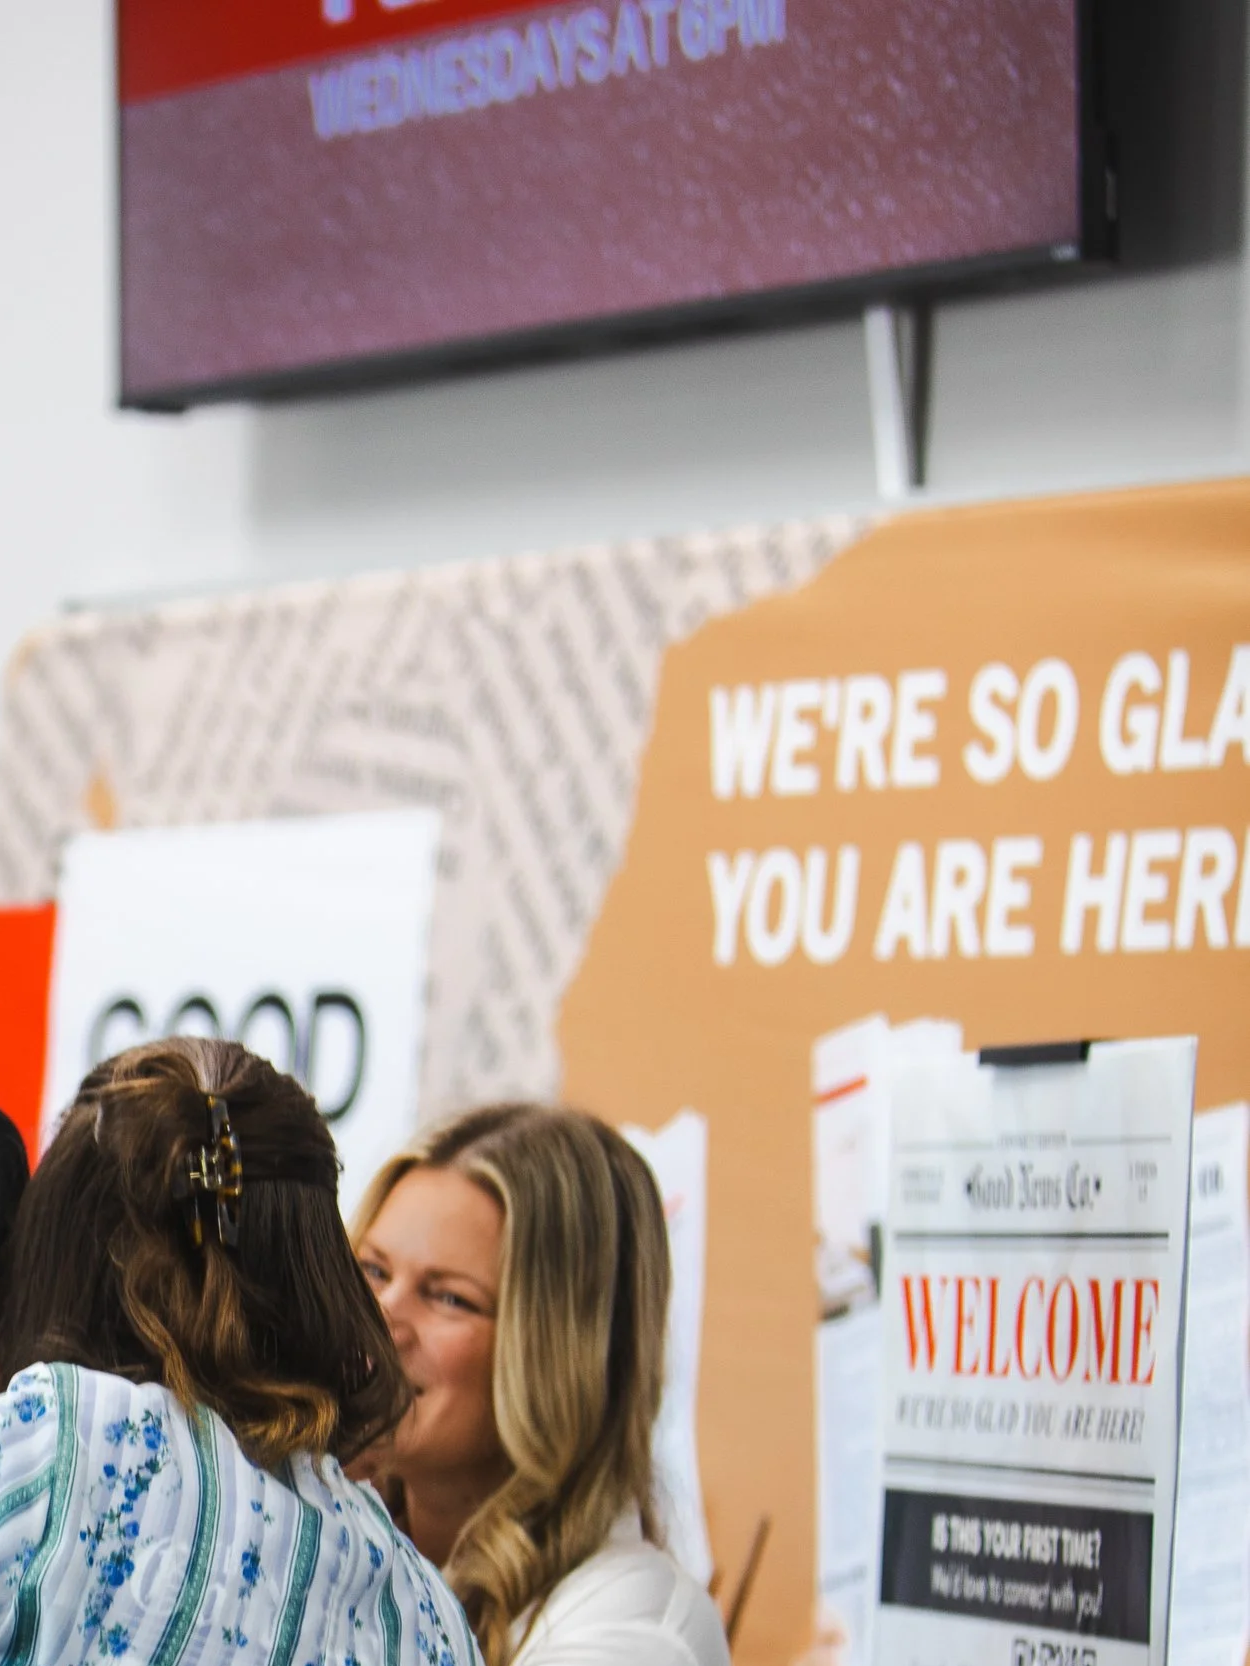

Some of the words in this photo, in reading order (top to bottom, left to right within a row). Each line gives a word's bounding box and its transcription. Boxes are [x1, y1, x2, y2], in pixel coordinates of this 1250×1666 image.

[308, 7, 612, 141] WEDNESDAYS
[612, 0, 675, 77] AT
[710, 668, 947, 801] WE'RE
[963, 657, 1080, 784] SO
[707, 843, 861, 967] YOU
[873, 836, 1043, 960] ARE
[1060, 826, 1250, 955] HER
[900, 1273, 1159, 1387] WELCOME
